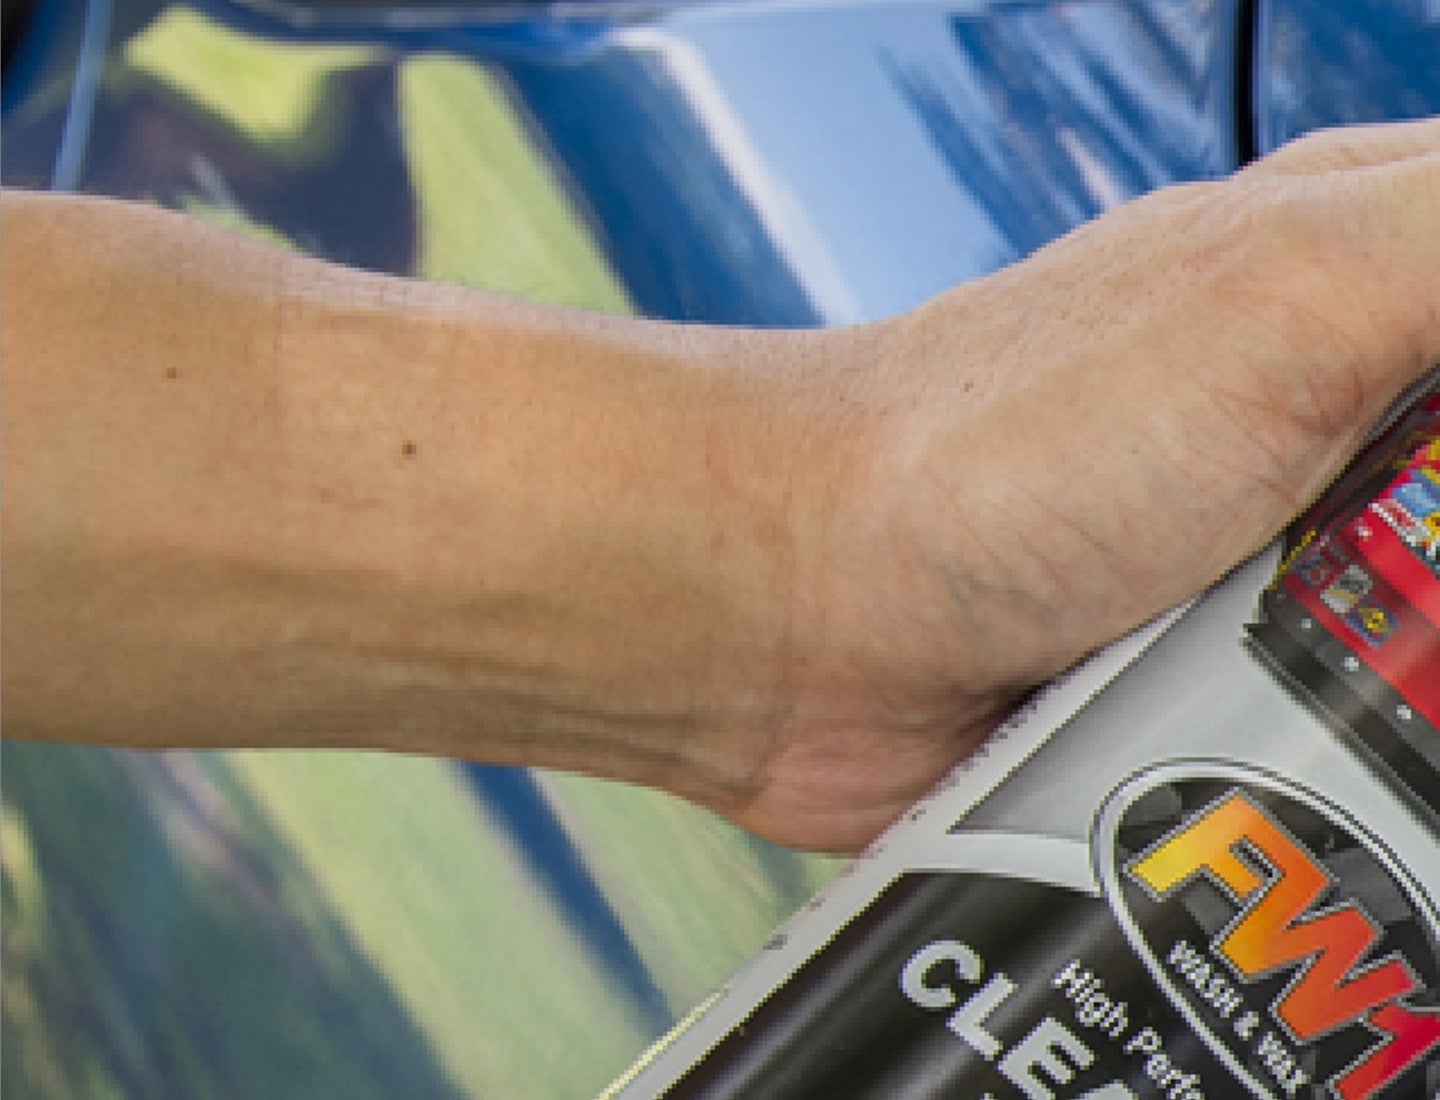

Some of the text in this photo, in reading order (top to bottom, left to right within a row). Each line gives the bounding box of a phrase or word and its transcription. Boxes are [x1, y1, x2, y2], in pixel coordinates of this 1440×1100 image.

[1050, 958, 1130, 1038] High
[1165, 939, 1312, 1098] WASH & WAX
